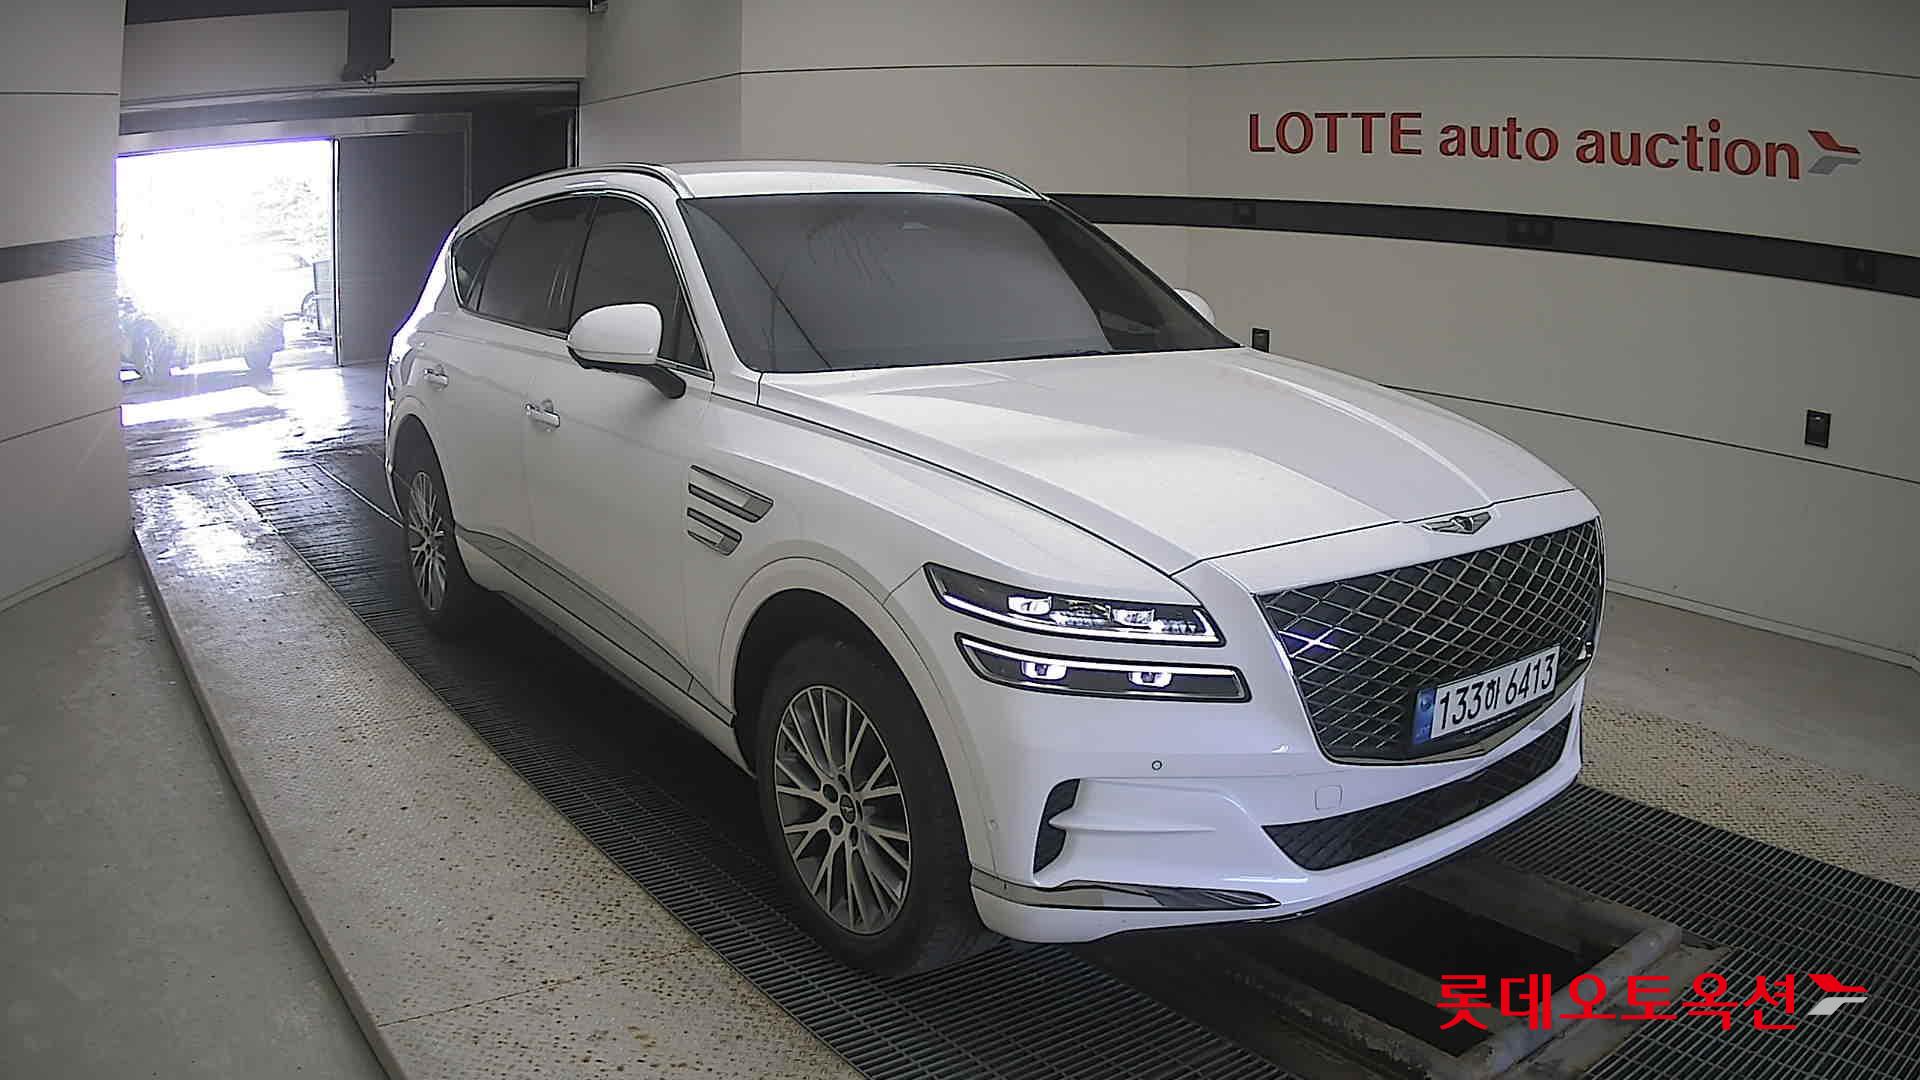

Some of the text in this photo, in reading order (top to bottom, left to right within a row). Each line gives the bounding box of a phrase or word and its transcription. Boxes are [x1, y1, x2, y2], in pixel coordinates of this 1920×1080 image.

[1249, 112, 1801, 180] LOTTE auto auction
[1505, 653, 1556, 705] 6413
